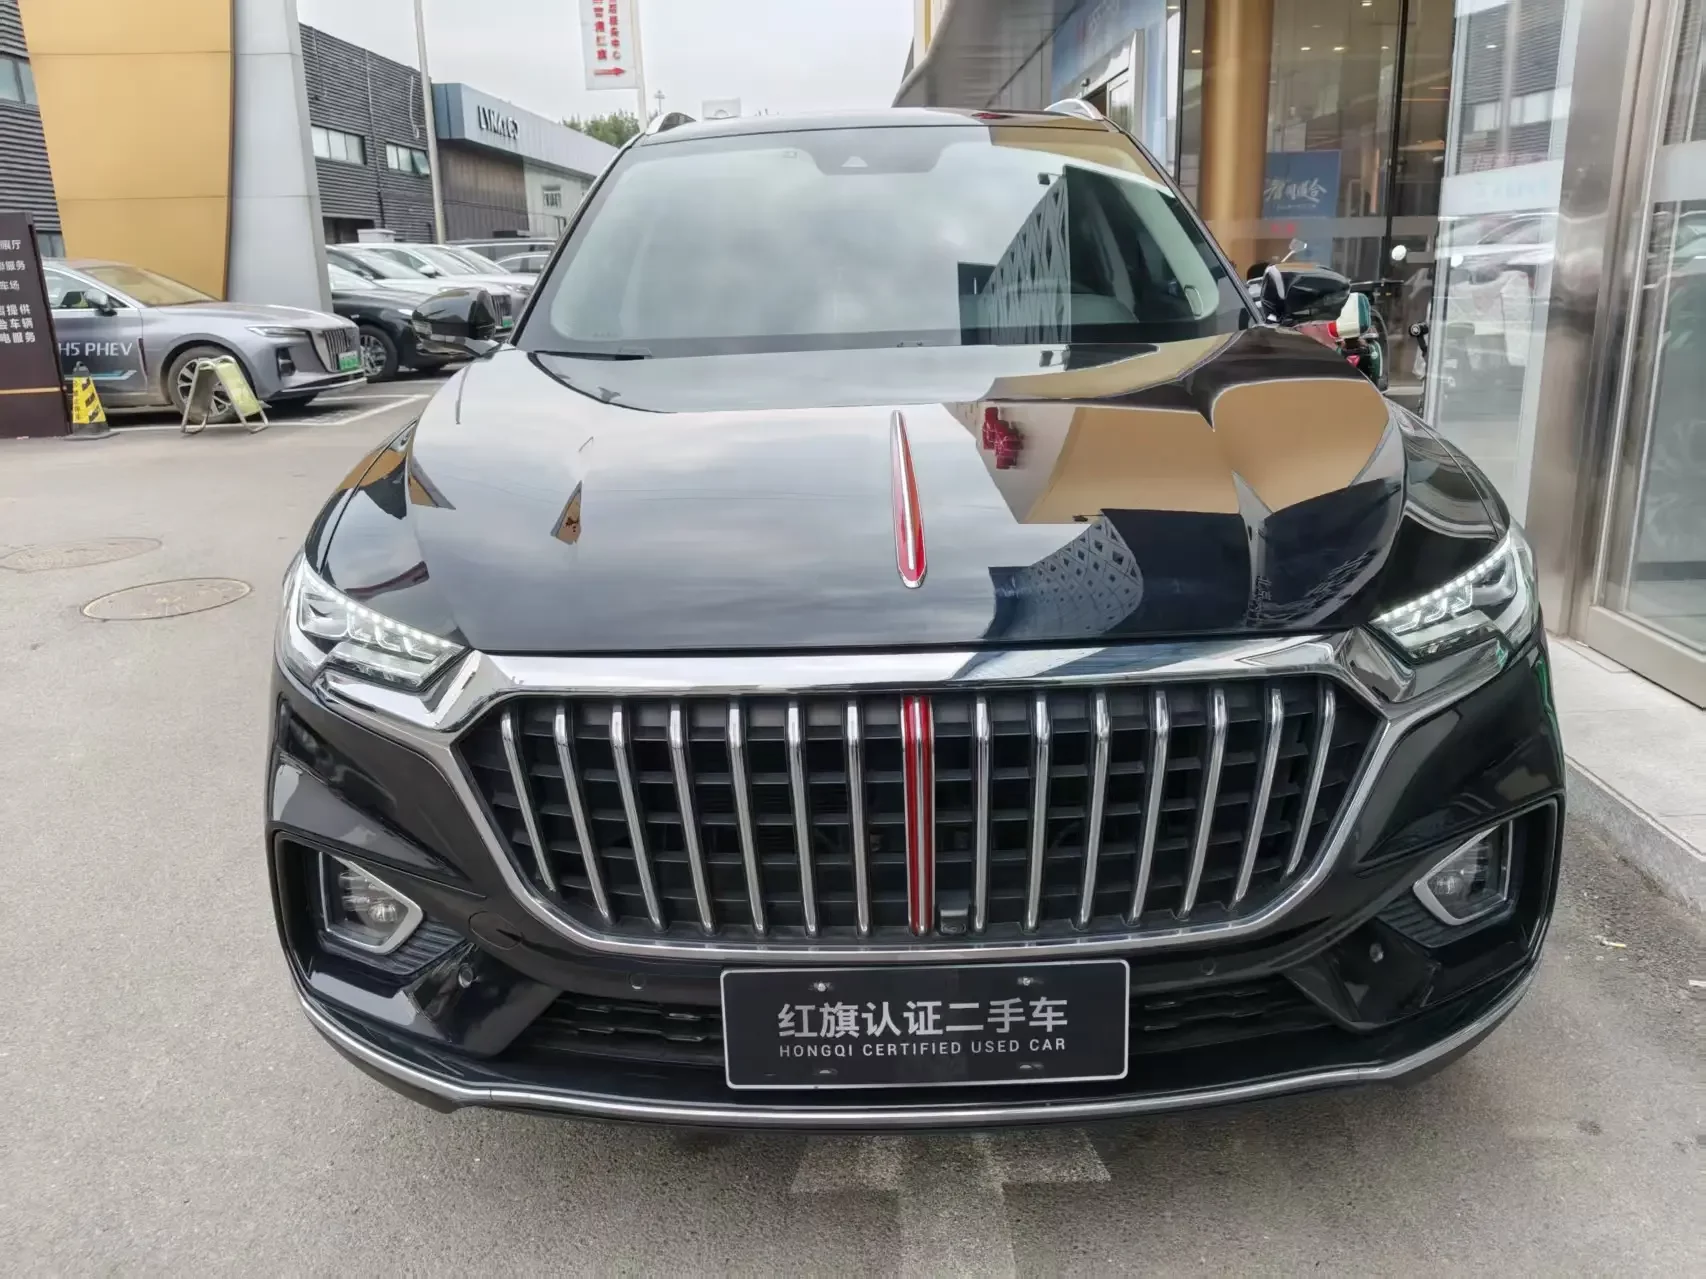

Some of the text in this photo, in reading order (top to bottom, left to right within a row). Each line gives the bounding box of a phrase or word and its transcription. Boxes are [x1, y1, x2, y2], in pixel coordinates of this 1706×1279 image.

[0, 239, 21, 250] 展厅
[59, 342, 133, 357] H5 PHEV
[777, 997, 1068, 1039] 红旗认证二手车
[779, 1037, 1067, 1059] HONGQI CERTIFIED USED CAR
